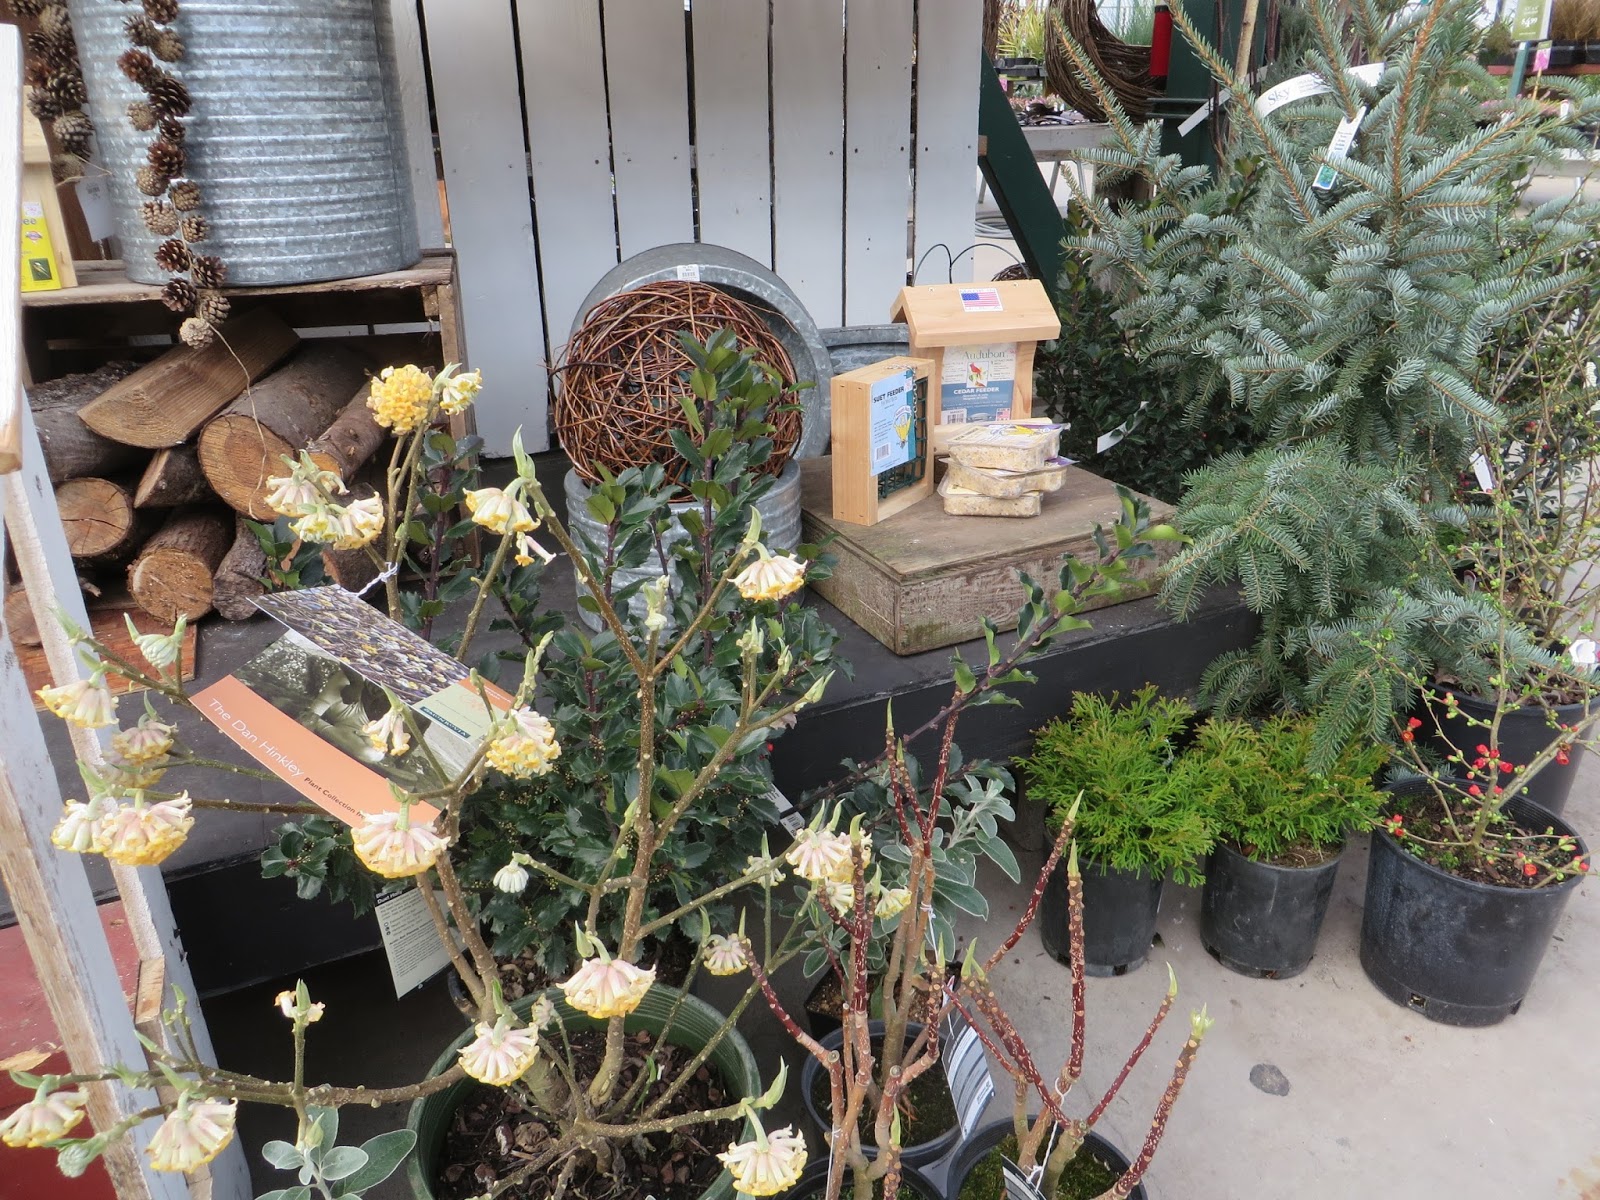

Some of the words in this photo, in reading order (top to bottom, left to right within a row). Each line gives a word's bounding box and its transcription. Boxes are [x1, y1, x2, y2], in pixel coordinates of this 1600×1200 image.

[1267, 87, 1291, 106] Sky
[964, 349, 1005, 360] Audubon
[887, 385, 904, 398] FEEDER
[209, 698, 231, 720] The
[231, 719, 258, 743] Dan
[258, 740, 305, 777] Hinkley
[304, 776, 322, 792] Plant
[322, 789, 356, 814] Collection
